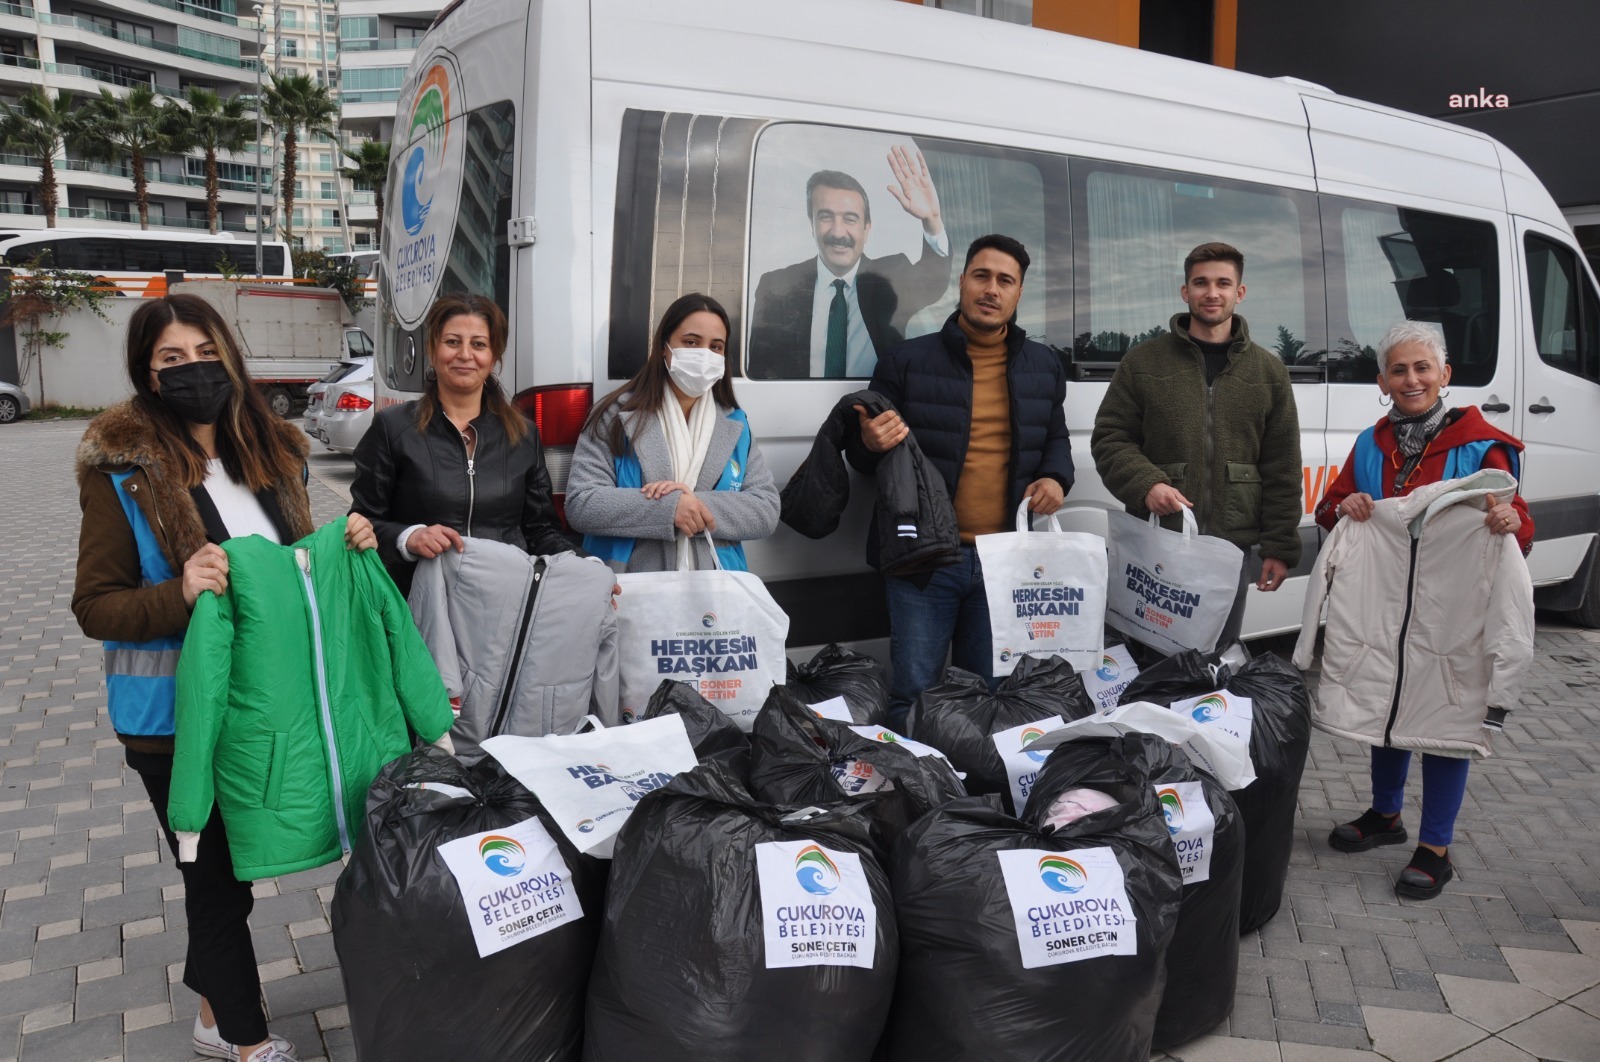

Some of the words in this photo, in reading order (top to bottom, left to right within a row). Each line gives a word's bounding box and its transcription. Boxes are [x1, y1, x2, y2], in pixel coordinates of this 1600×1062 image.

[1031, 621, 1060, 629] SONER
[657, 654, 757, 677] BAŞKANI
[700, 679, 742, 689] SONER
[478, 872, 562, 914] ÇUKUROVA
[777, 905, 865, 925] ÇUKUROVA
[1027, 898, 1121, 924] ÇUKUROVA
[498, 915, 535, 936] SONER
[1046, 935, 1086, 951] SONER
